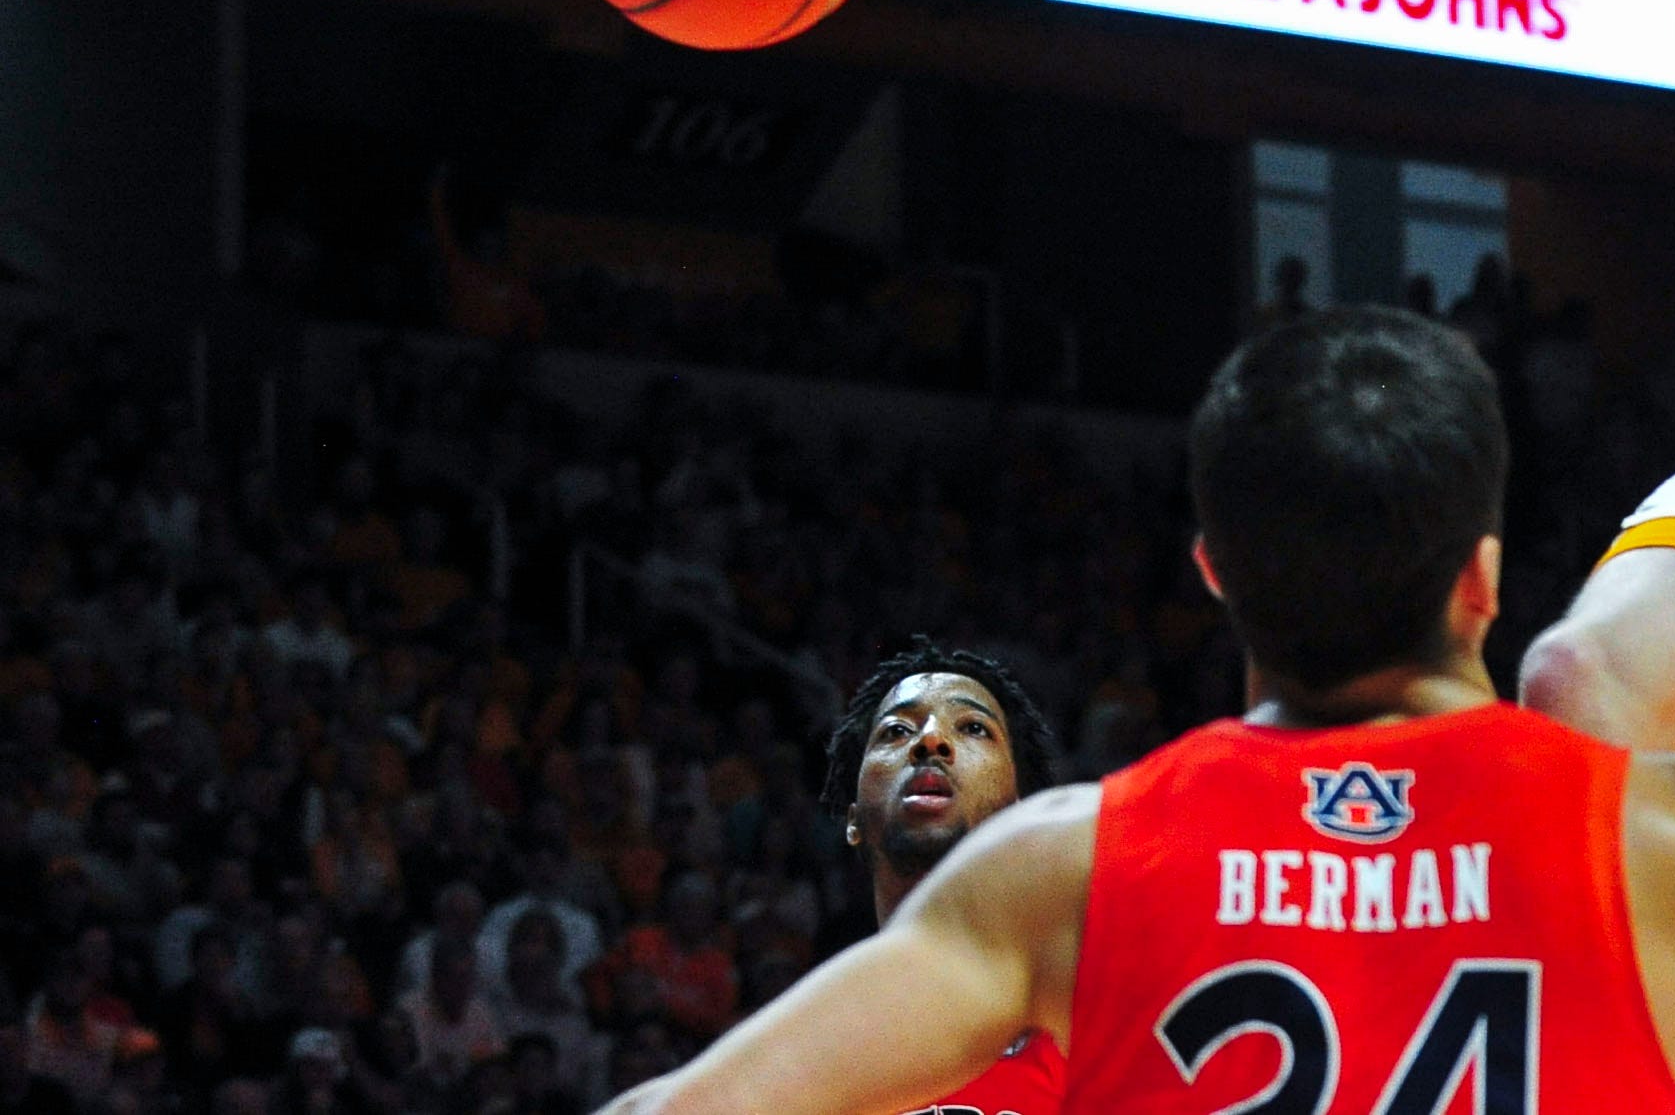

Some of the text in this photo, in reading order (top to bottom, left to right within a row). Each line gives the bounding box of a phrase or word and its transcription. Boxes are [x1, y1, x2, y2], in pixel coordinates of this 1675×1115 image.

[632, 95, 776, 164] 106
[1216, 841, 1493, 932] BERMAN
[1152, 957, 1543, 1115] 24
